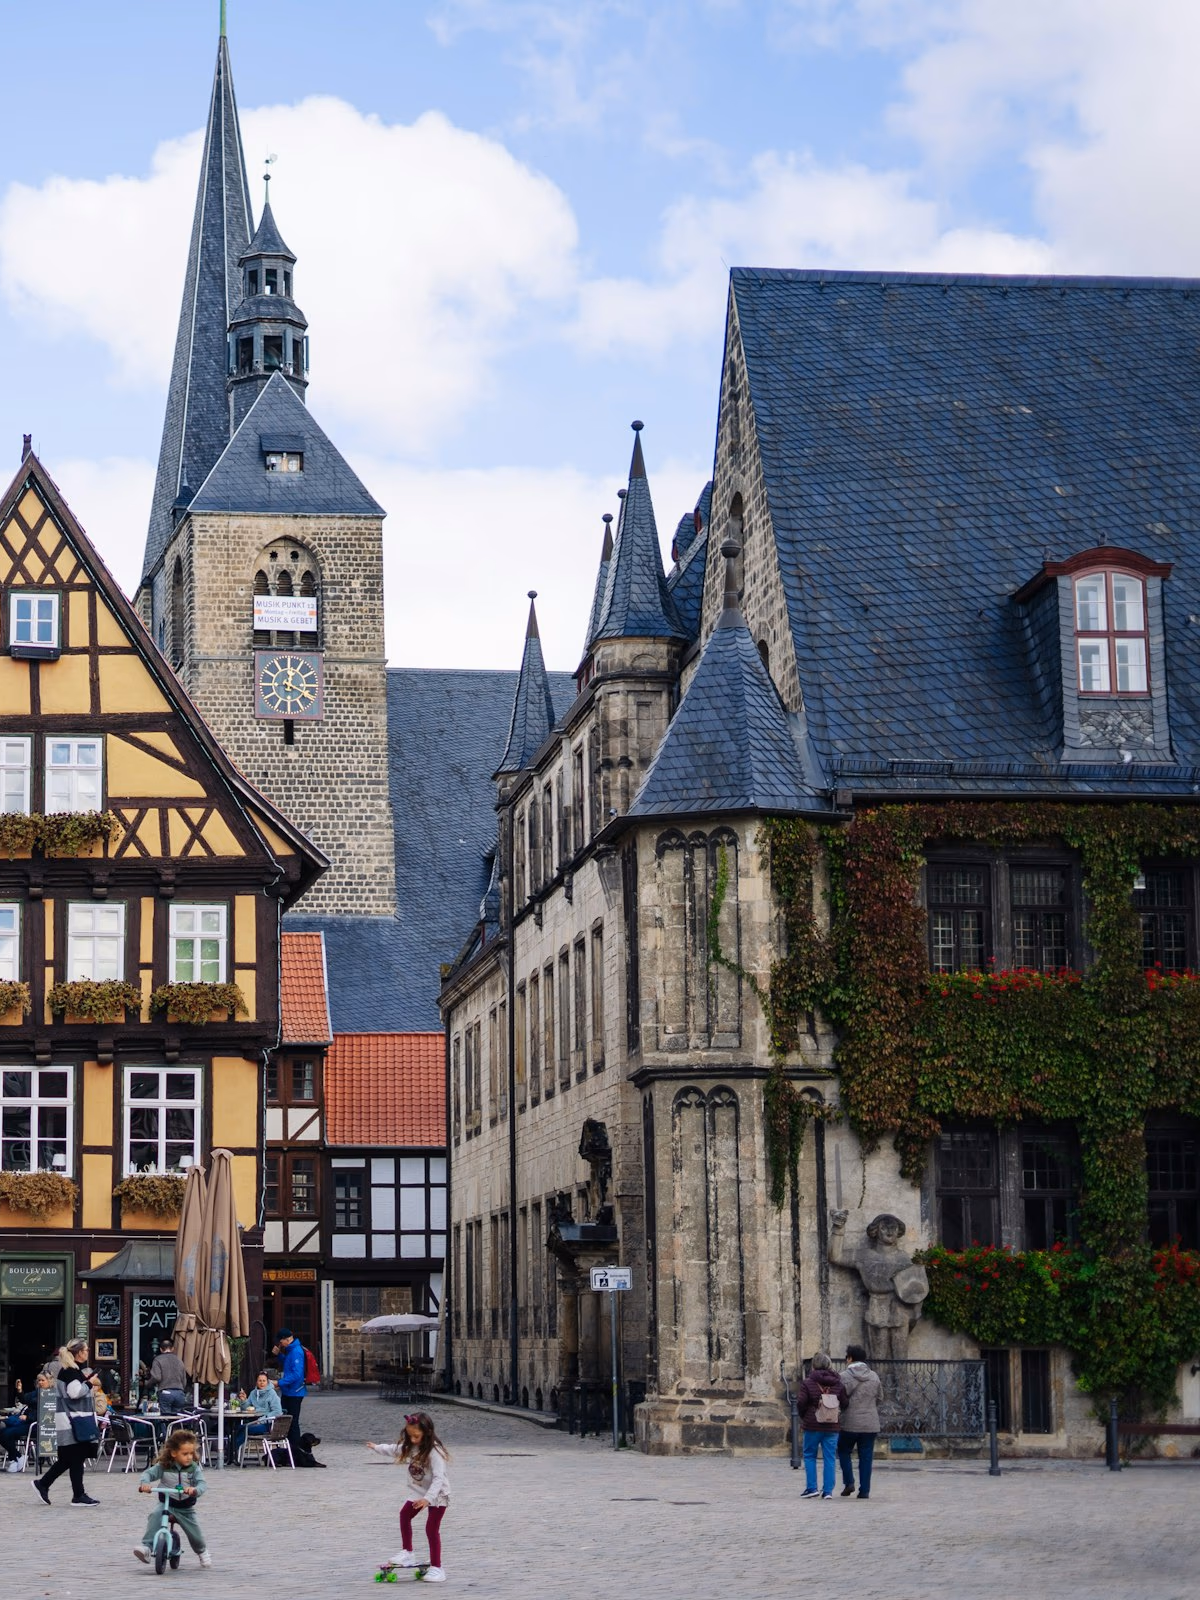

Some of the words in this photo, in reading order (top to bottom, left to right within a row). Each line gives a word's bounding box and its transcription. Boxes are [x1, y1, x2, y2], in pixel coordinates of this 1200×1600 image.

[255, 600, 280, 608] MUSIK
[257, 616, 282, 624] MUSIK
[277, 1271, 314, 1280] BURGER
